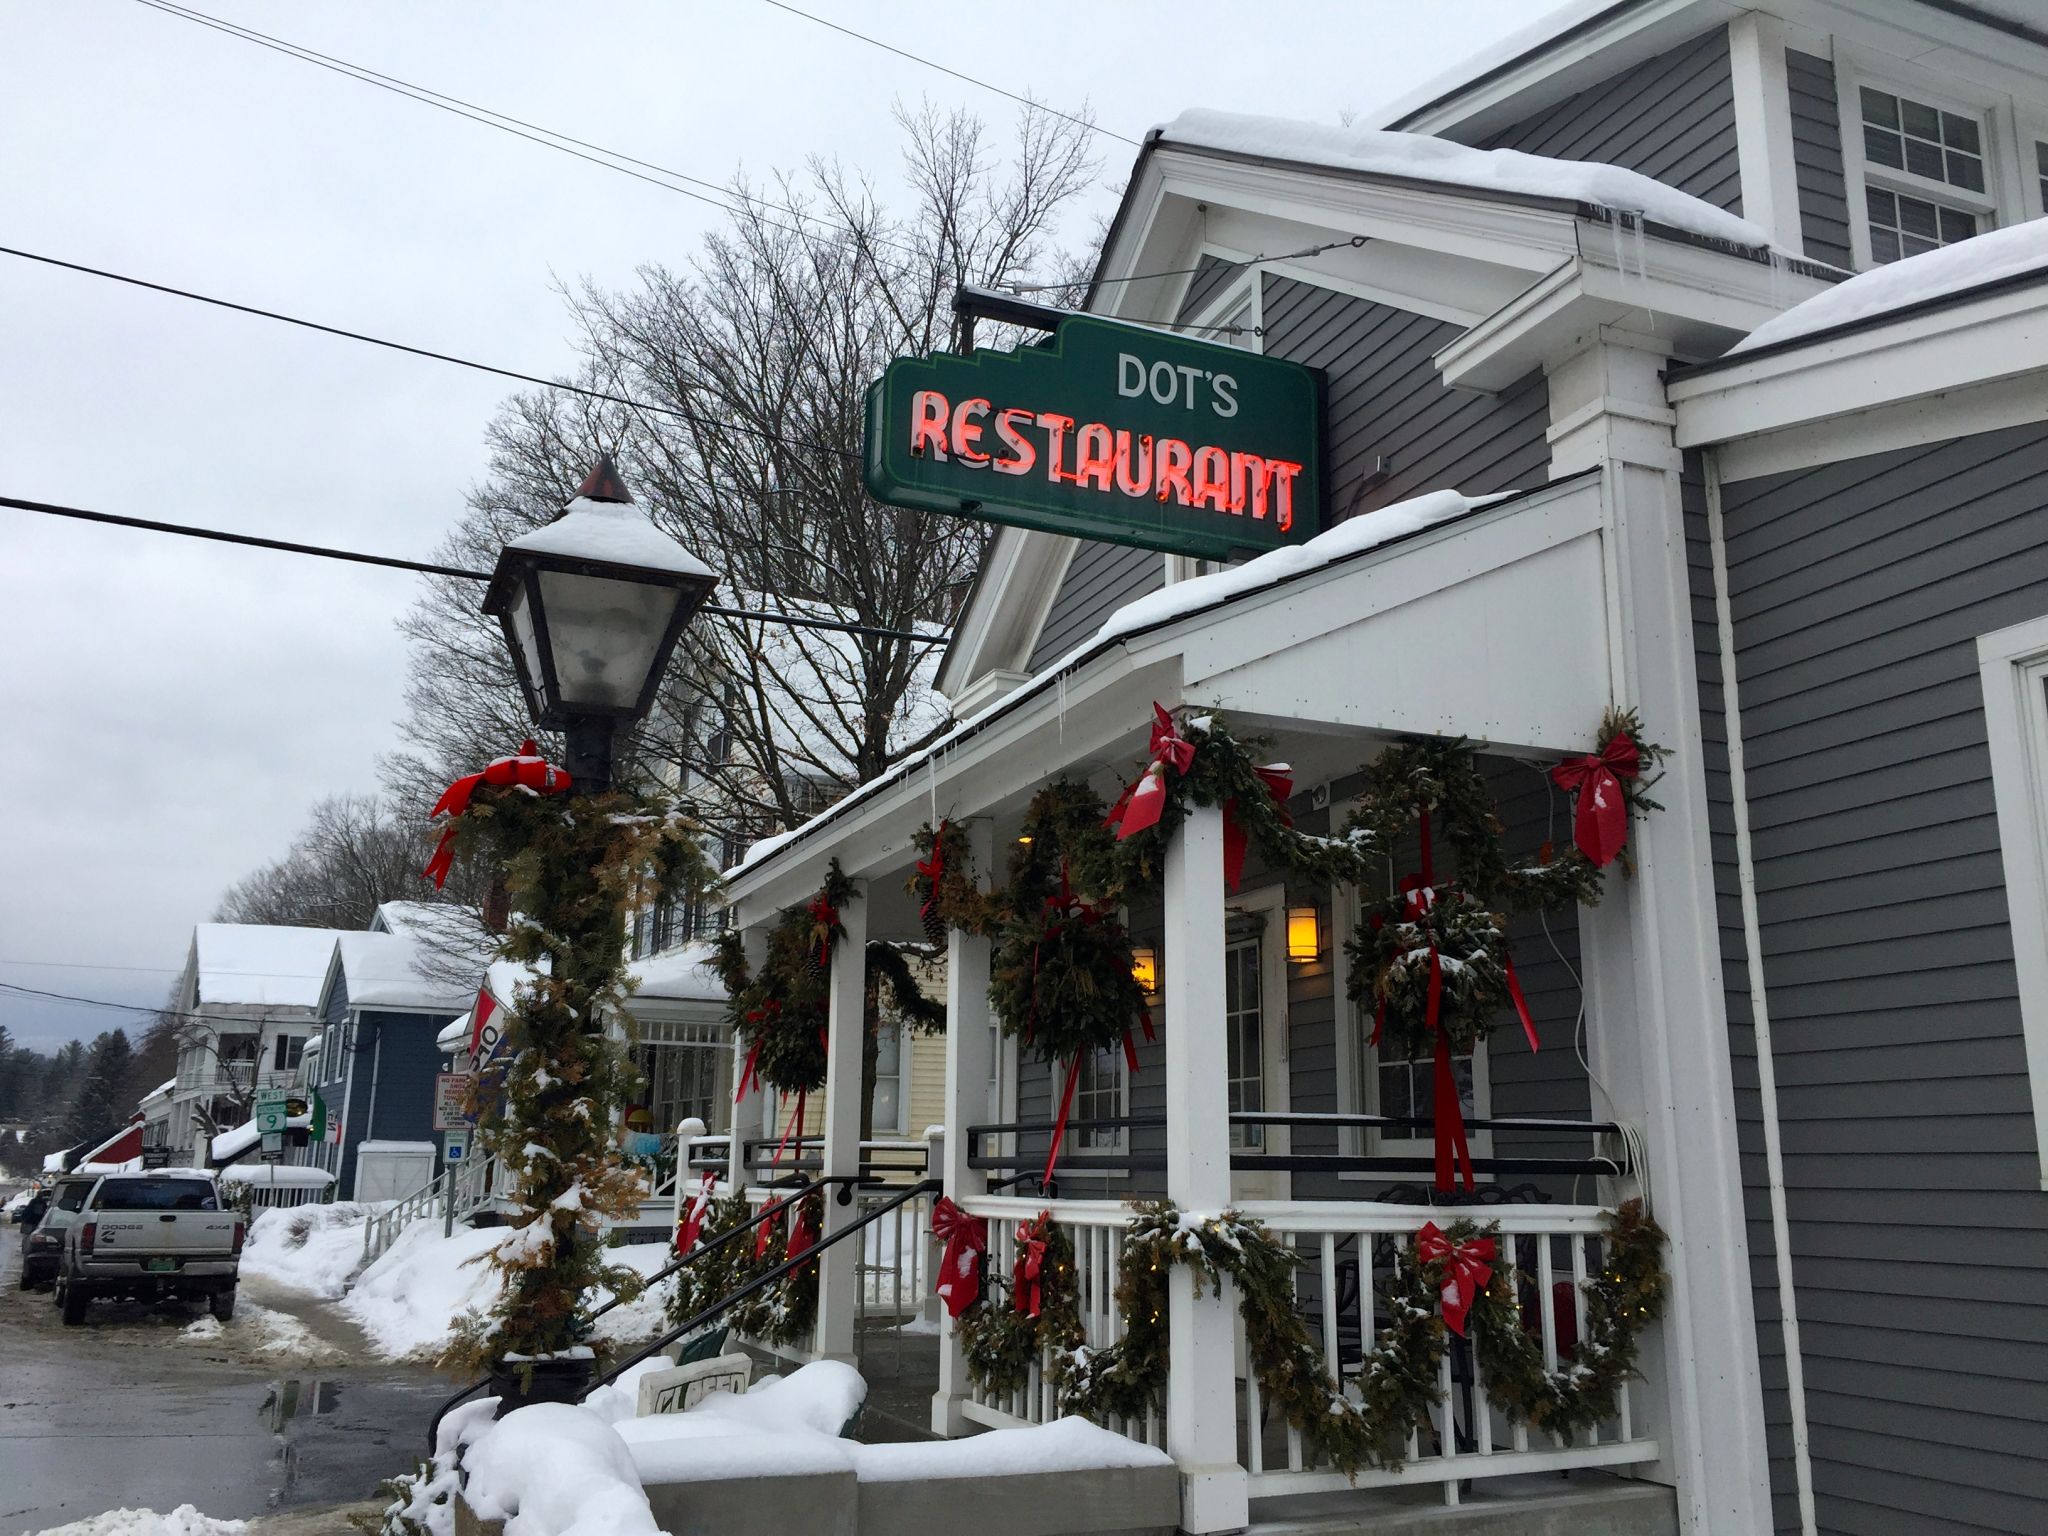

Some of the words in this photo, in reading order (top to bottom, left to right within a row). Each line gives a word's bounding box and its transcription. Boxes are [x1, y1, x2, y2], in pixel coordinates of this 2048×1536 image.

[1118, 352, 1239, 418] DOT'S
[911, 390, 1302, 532] RESTAURANT
[260, 1090, 283, 1101] WEST
[266, 1114, 277, 1128] 9
